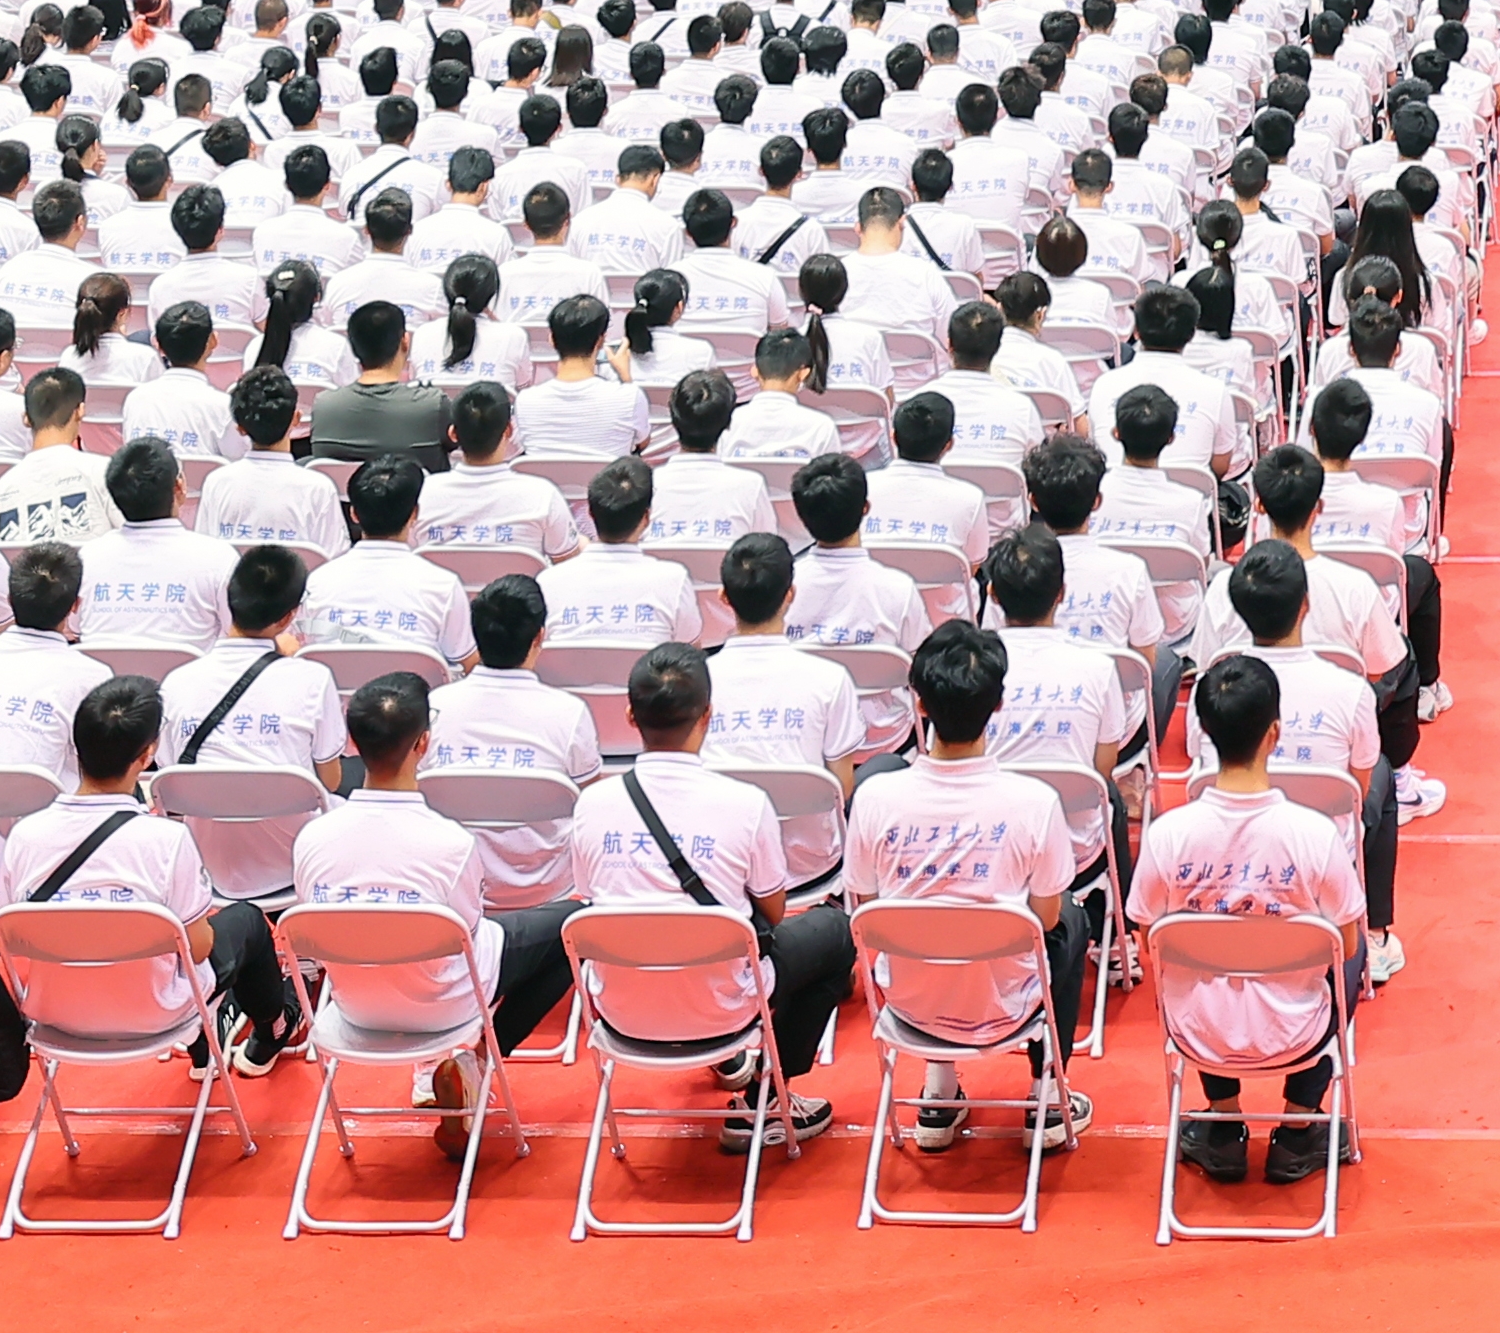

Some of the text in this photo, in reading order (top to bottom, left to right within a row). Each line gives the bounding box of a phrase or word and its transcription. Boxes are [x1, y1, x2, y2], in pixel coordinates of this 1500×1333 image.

[427, 523, 514, 543] 航天学院
[650, 518, 733, 538] 航天学院
[865, 516, 949, 543] 航天学院
[93, 581, 187, 604] 航天学院
[328, 607, 418, 633] 航天学院
[562, 603, 655, 625] 航天学院
[787, 624, 876, 646] 航天学院
[707, 707, 805, 733] 航天学院
[437, 744, 535, 769] 航天学院
[897, 862, 989, 879] 航海学院
